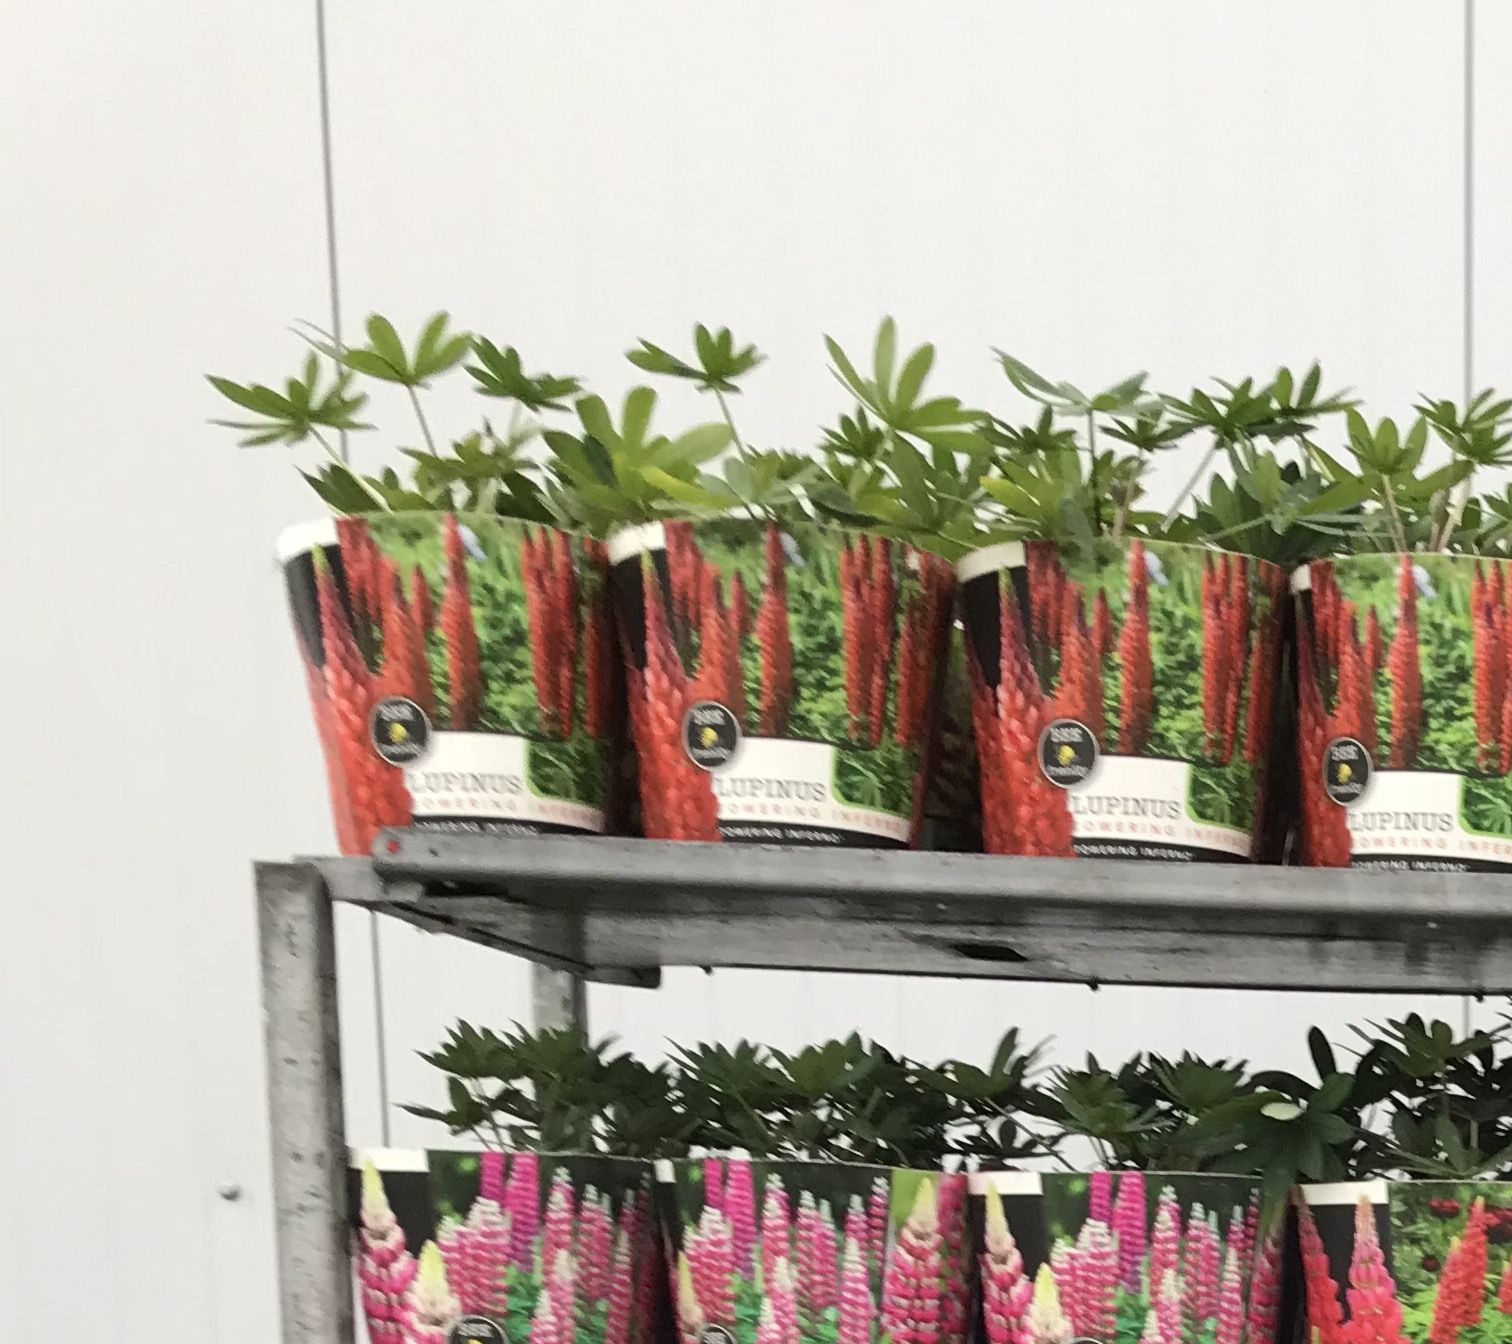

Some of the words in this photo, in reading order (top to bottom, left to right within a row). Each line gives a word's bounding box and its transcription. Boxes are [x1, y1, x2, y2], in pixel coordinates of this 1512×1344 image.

[715, 777, 826, 801] LUPINUS
[1071, 796, 1183, 820] LUPINUS
[1348, 811, 1454, 832] LUPINUS
